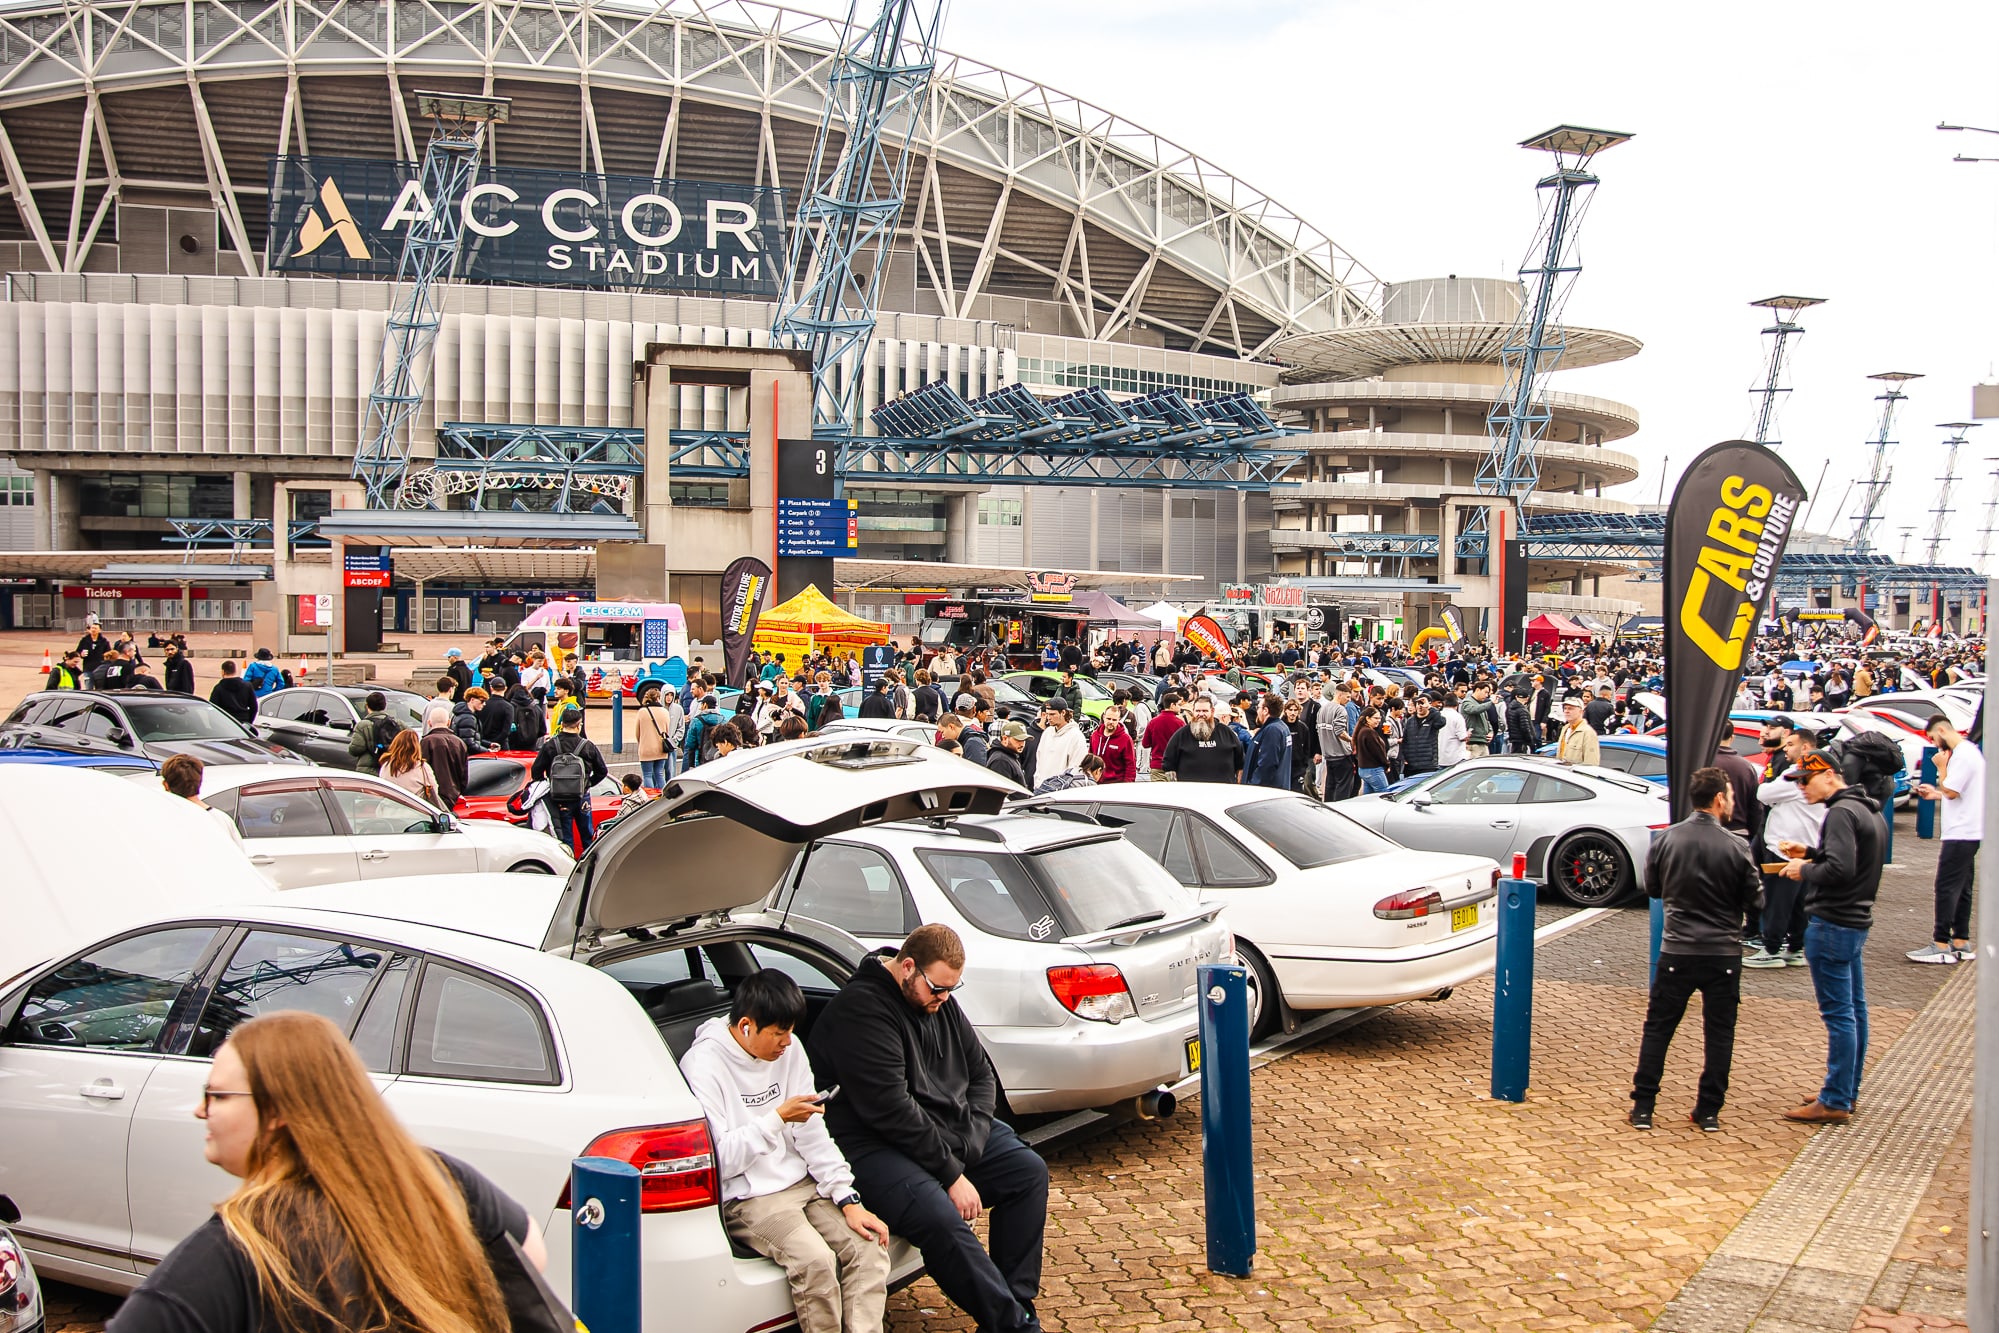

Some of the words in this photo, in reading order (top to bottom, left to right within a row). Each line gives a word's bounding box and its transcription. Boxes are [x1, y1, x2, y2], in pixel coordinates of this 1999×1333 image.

[381, 180, 759, 252] ACCOR
[547, 245, 760, 281] STADIUM
[815, 449, 827, 475] 3
[1751, 492, 1797, 580] CULTURE
[1519, 543, 1526, 558] 5
[350, 578, 383, 586] ABCDEF
[1680, 475, 1773, 671] CARS
[84, 587, 122, 598] Tickets
[735, 571, 753, 607] CULTURE
[753, 576, 766, 601] AUSTRALIA
[1745, 580, 1767, 602] &
[579, 605, 599, 616] ICE
[600, 605, 644, 617] CREAM
[728, 604, 743, 632] MOTOR
[1189, 620, 1233, 660] SUPERCHEAP
[1190, 633, 1206, 646] AUTO
